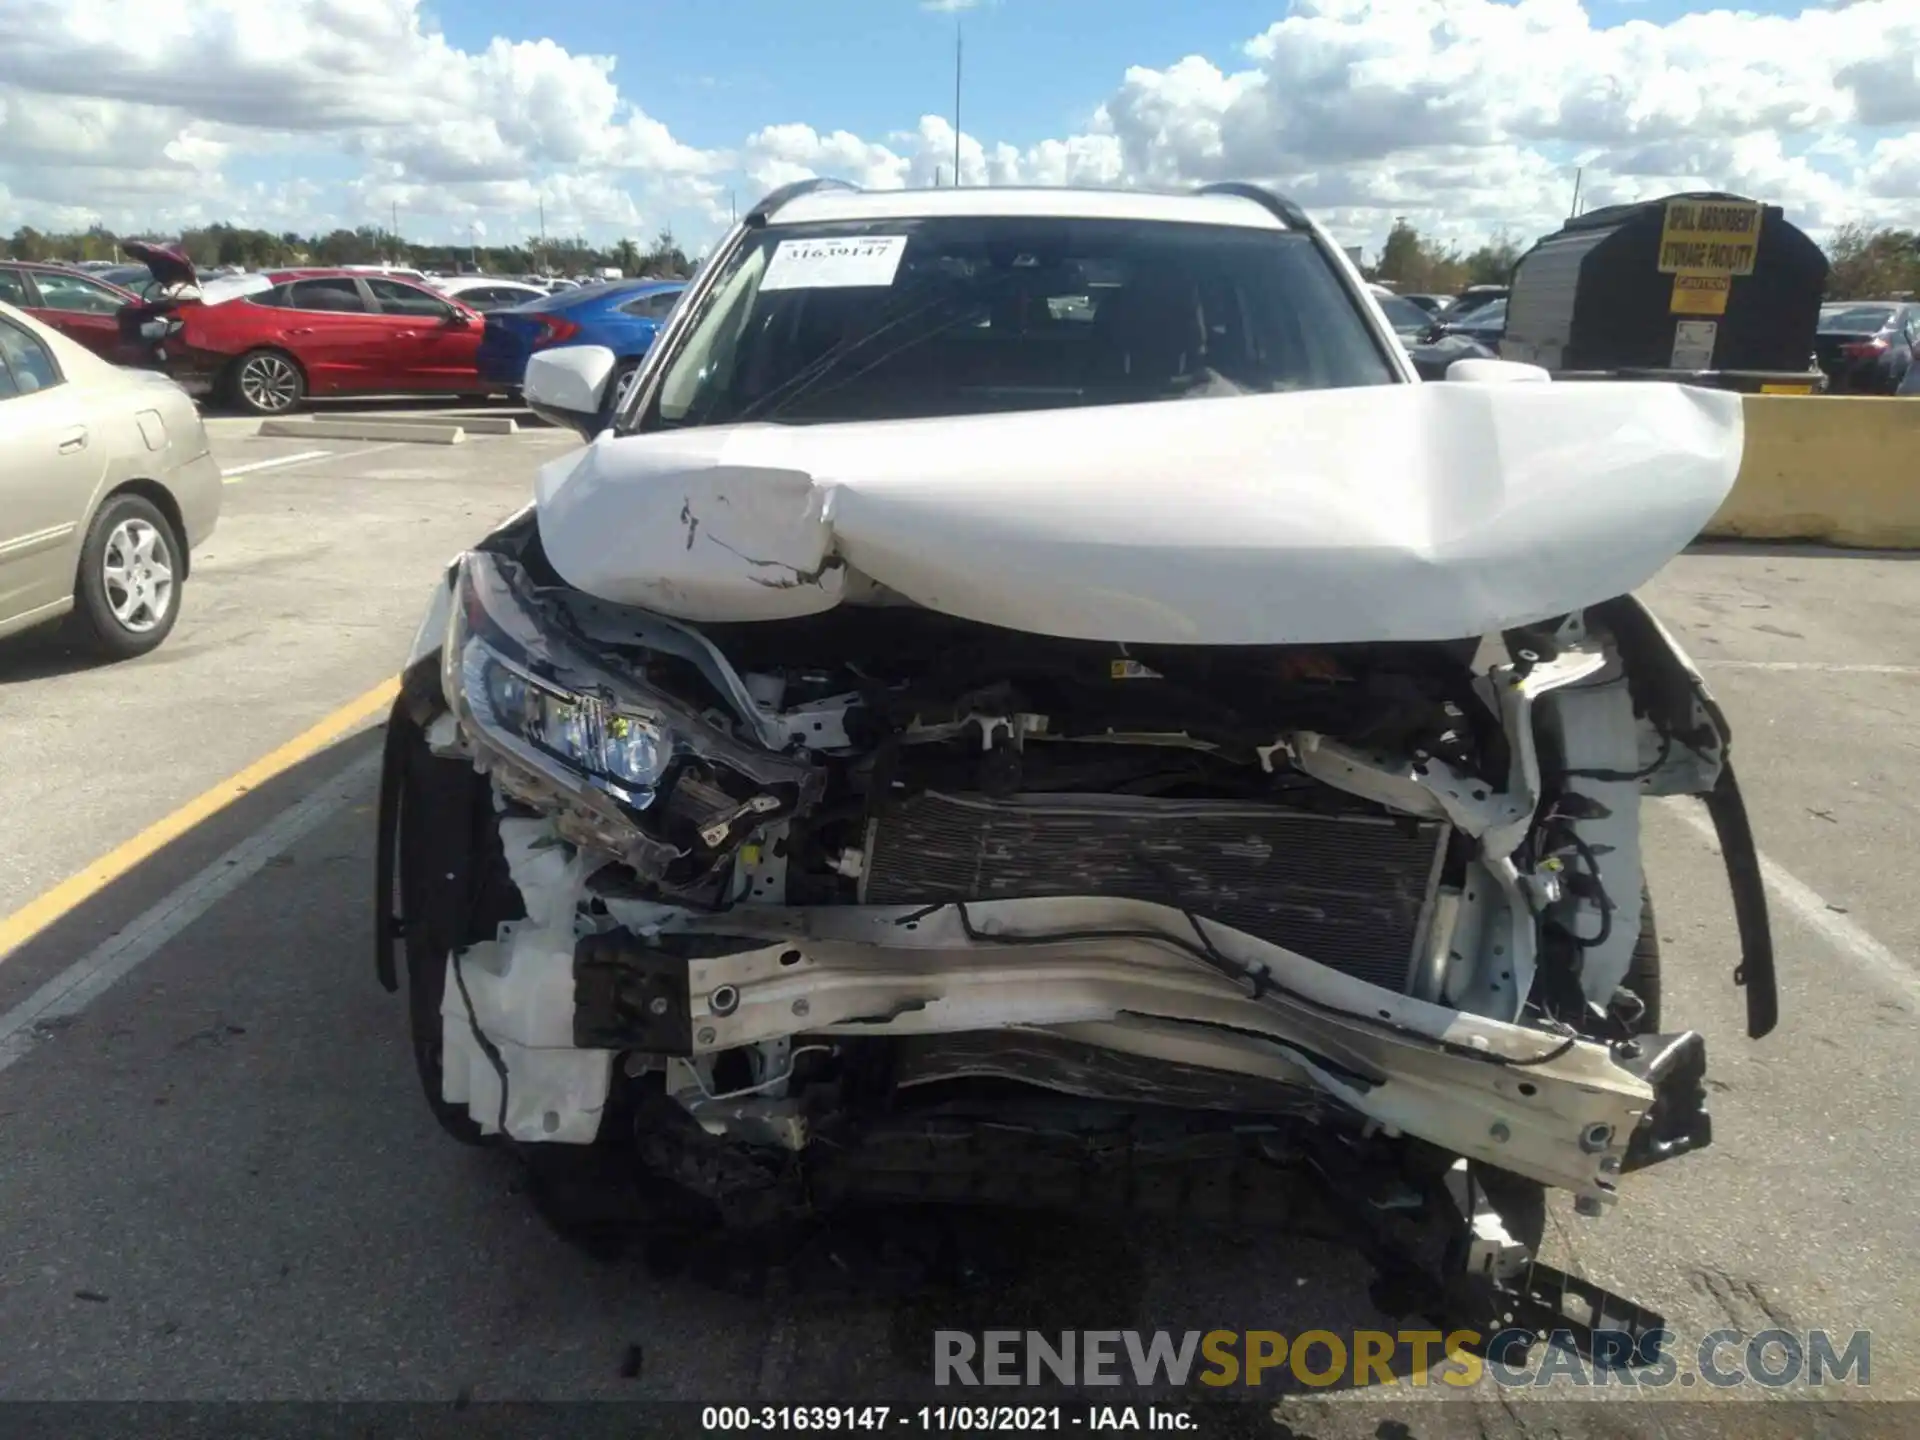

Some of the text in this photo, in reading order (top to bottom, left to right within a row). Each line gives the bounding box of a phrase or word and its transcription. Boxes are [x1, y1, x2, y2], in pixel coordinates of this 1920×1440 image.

[1669, 204, 1758, 233] SPILL ABSORBENT
[787, 246, 888, 260] 31639147
[1662, 241, 1753, 270] STORAGE FACILITY
[1679, 276, 1727, 290] CAUTION
